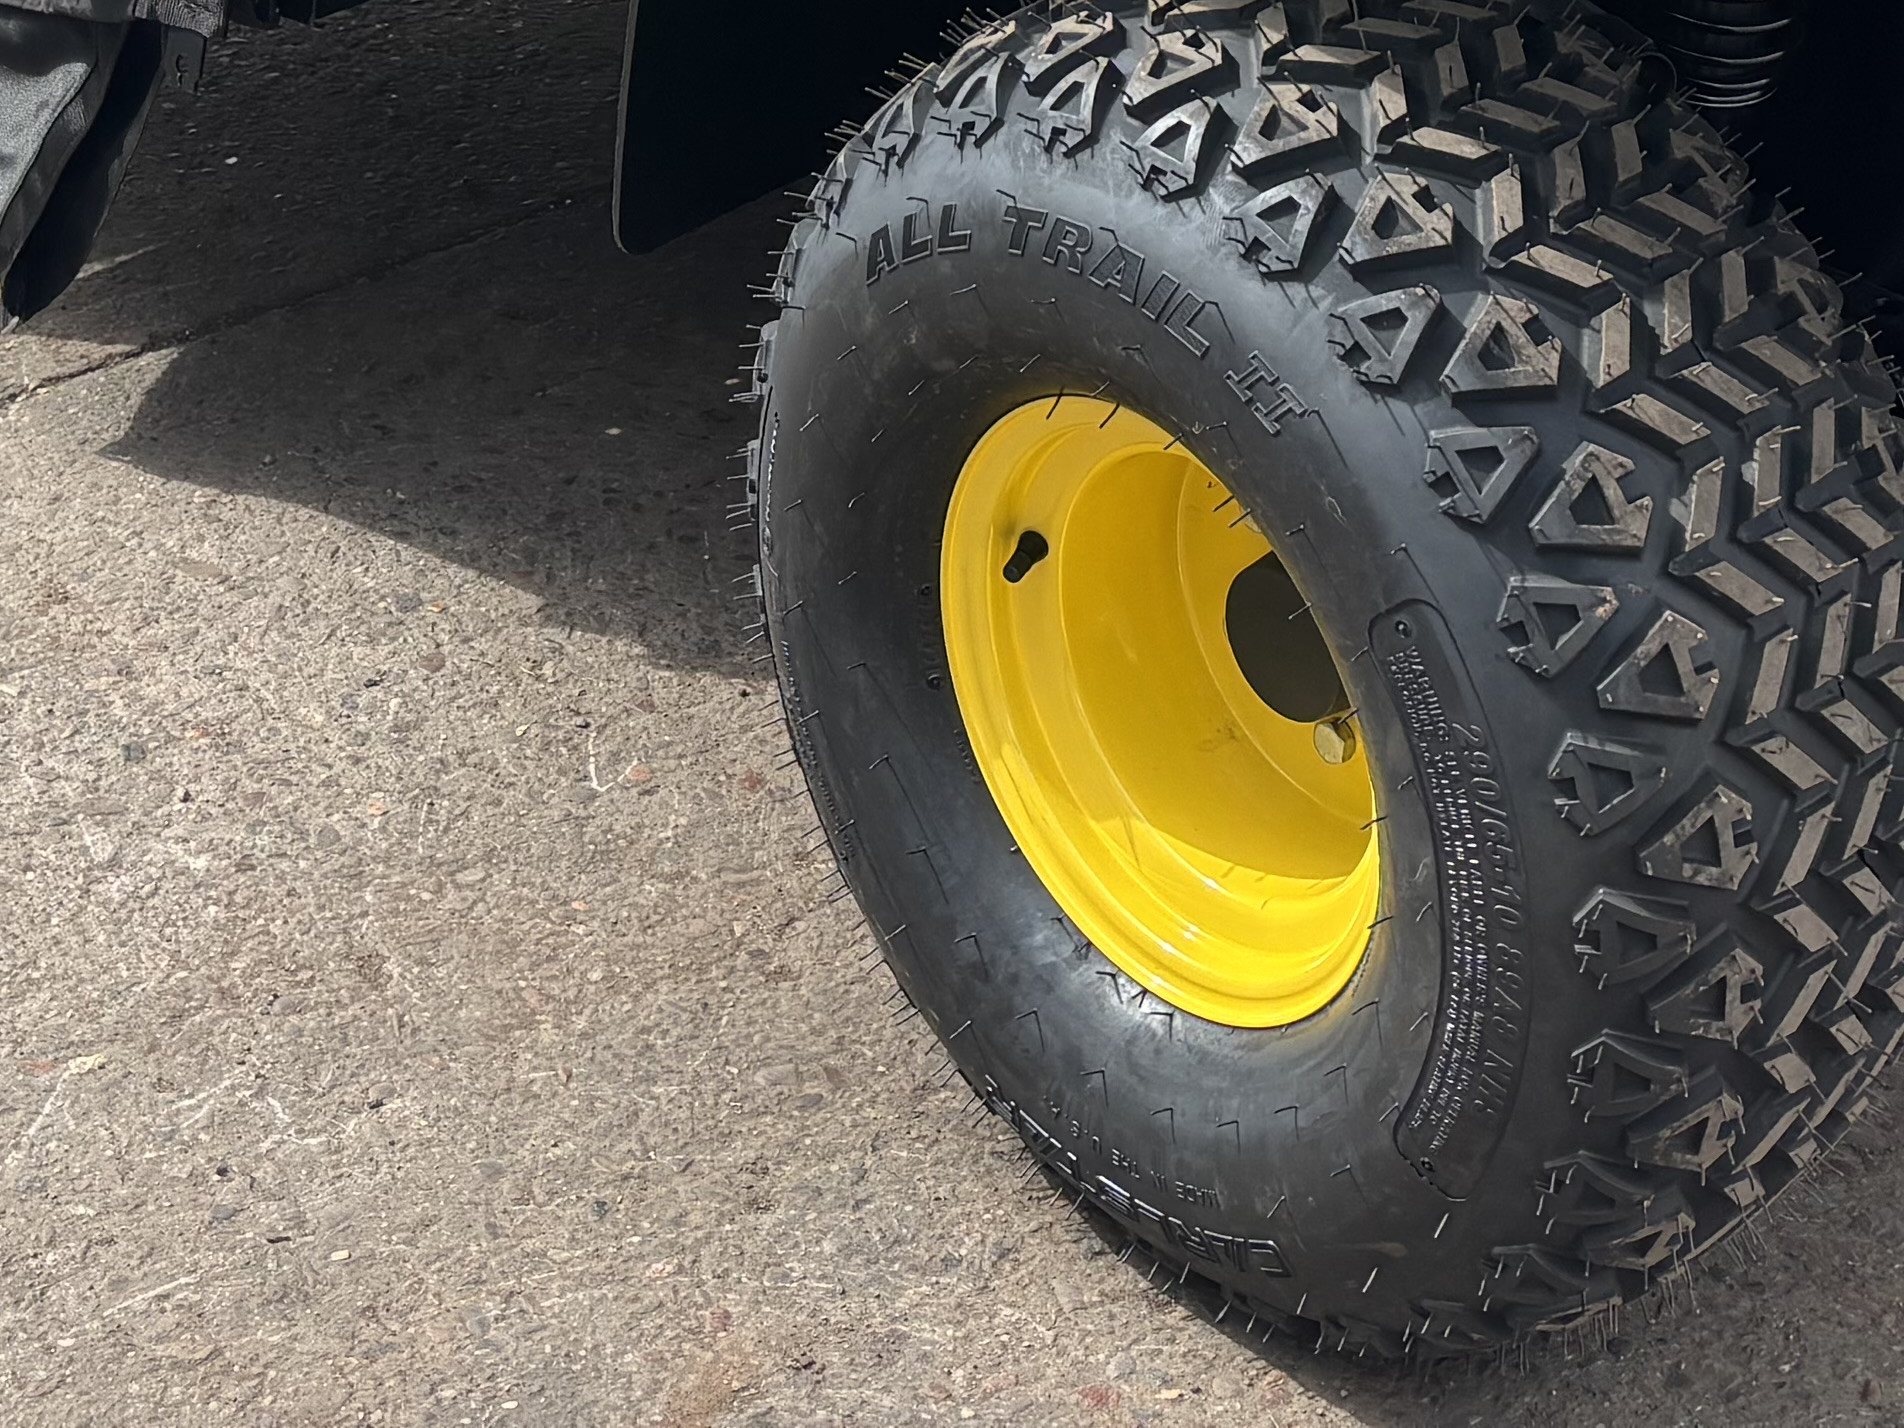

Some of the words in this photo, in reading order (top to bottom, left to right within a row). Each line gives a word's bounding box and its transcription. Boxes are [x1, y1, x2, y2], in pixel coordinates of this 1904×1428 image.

[865, 202, 973, 287] ALL
[1002, 204, 1211, 359] TRAIL
[1223, 350, 1310, 437] II
